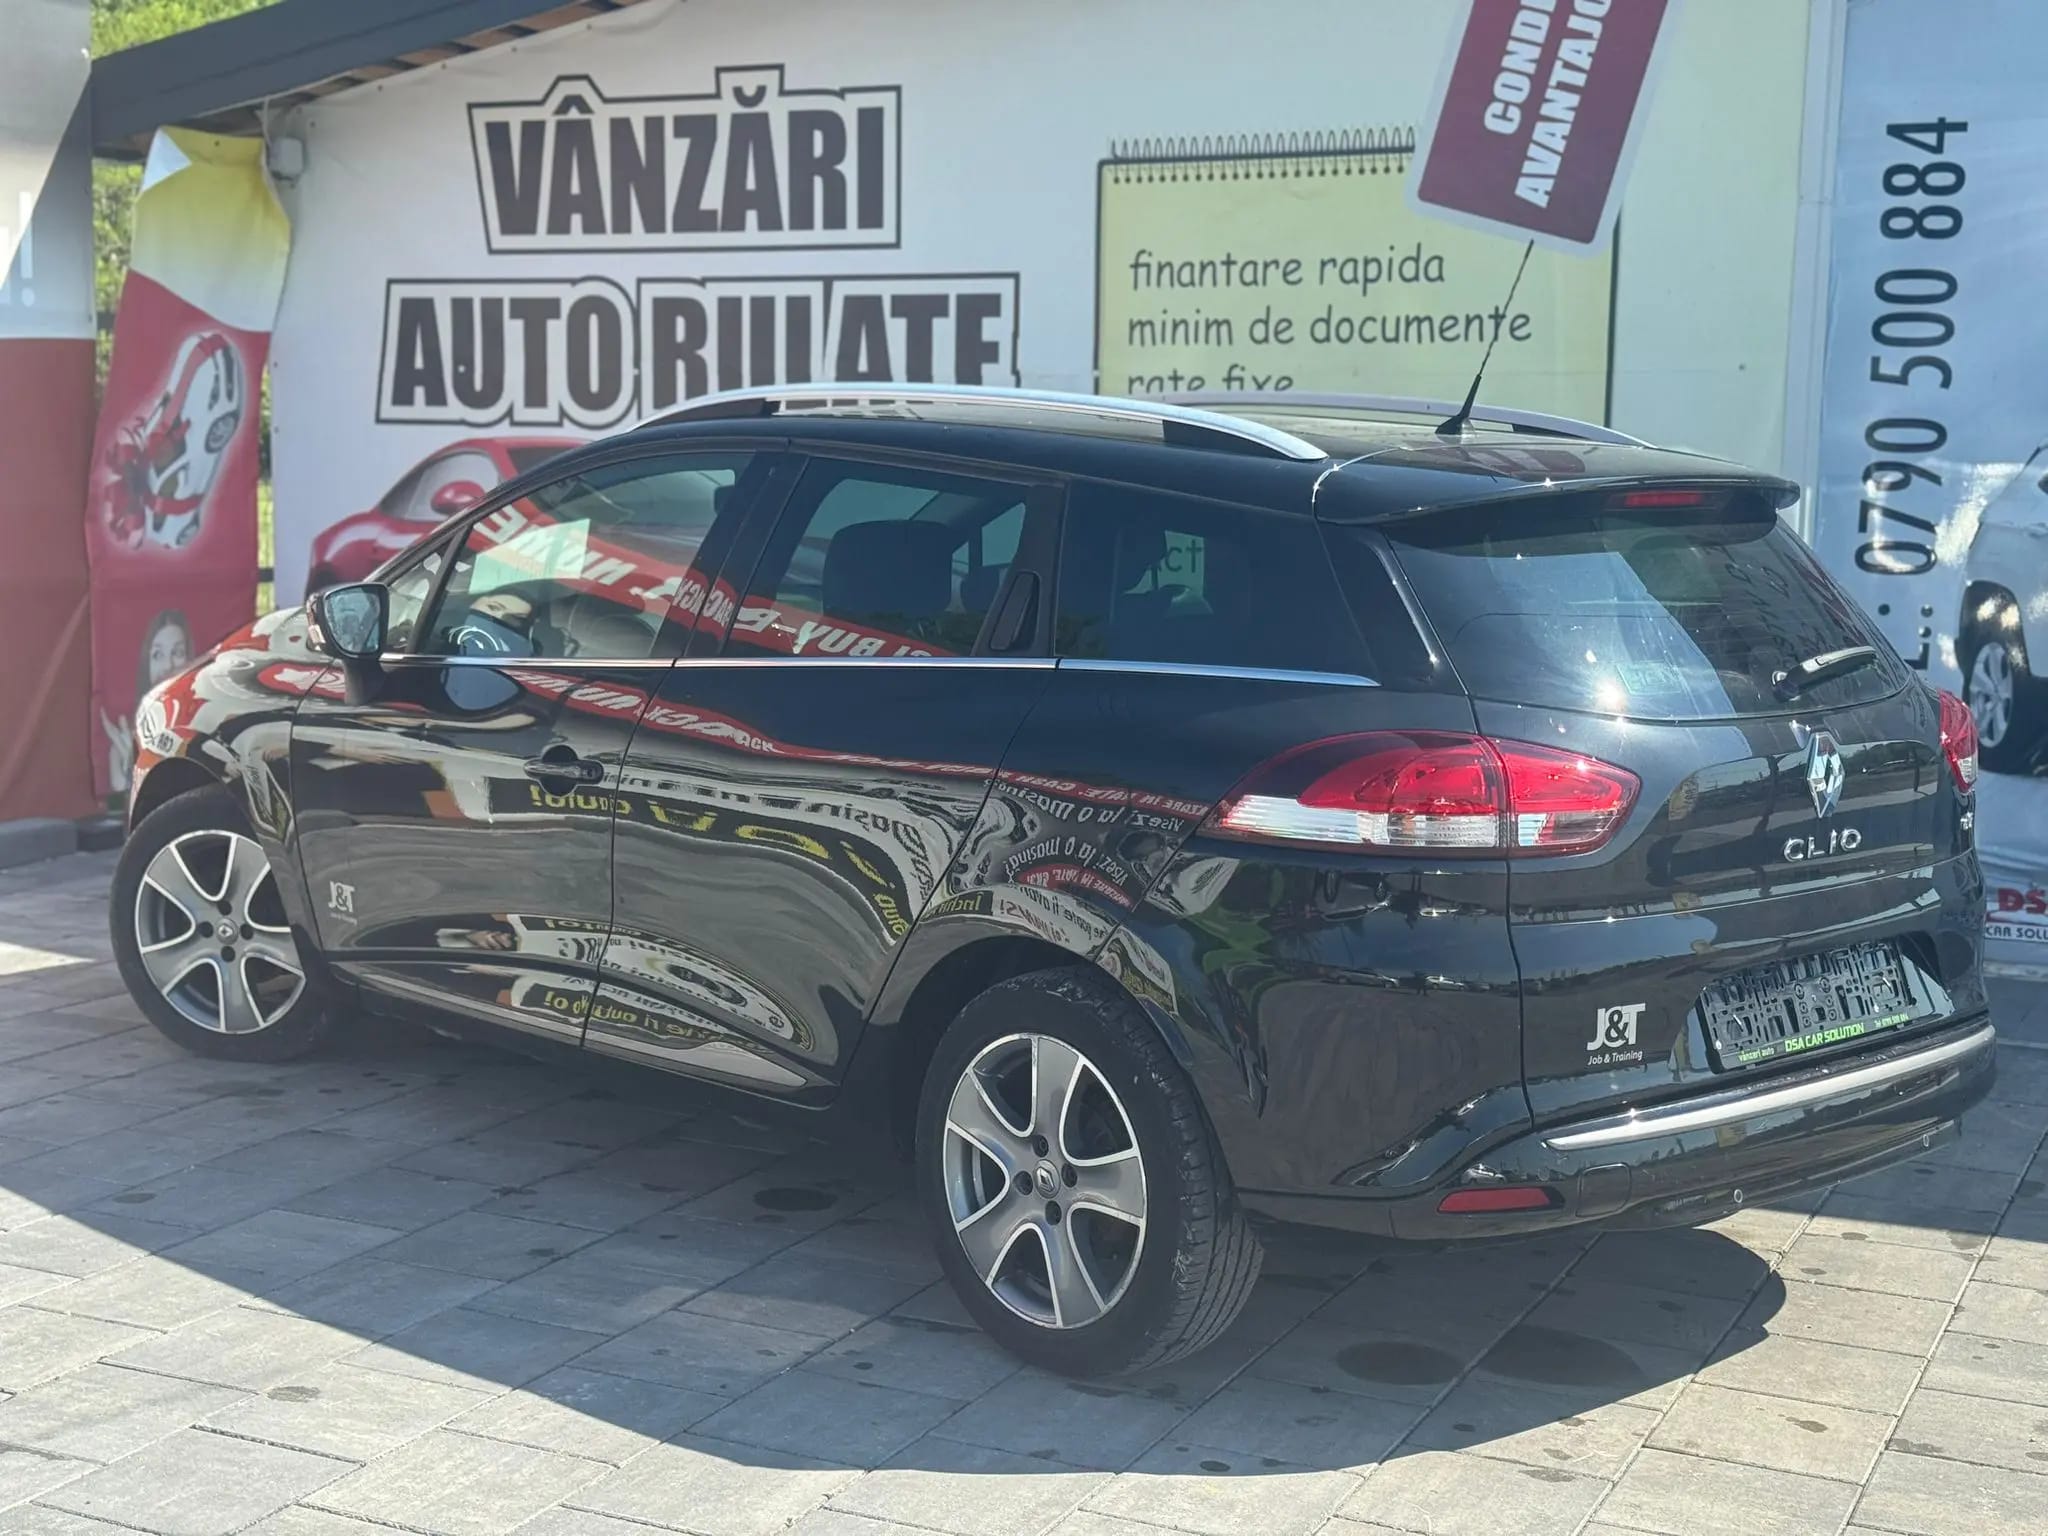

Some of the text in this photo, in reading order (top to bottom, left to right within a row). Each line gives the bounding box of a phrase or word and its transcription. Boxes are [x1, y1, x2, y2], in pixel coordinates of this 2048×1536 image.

[485, 83, 885, 236] VÂNZĂRI
[1880, 117, 1968, 240] 884
[1130, 243, 1445, 297] finantare rapida
[1128, 304, 1532, 346] minim de documente
[1870, 268, 1958, 390] 500
[1854, 417, 1948, 576] 0790
[1783, 828, 1863, 863] CLIO
[328, 880, 355, 912] J&T
[1586, 1002, 1646, 1051] J&T
[1784, 1022, 1865, 1053] DSA CAR SOLUTION
[1587, 1050, 1643, 1066] Job & Training
